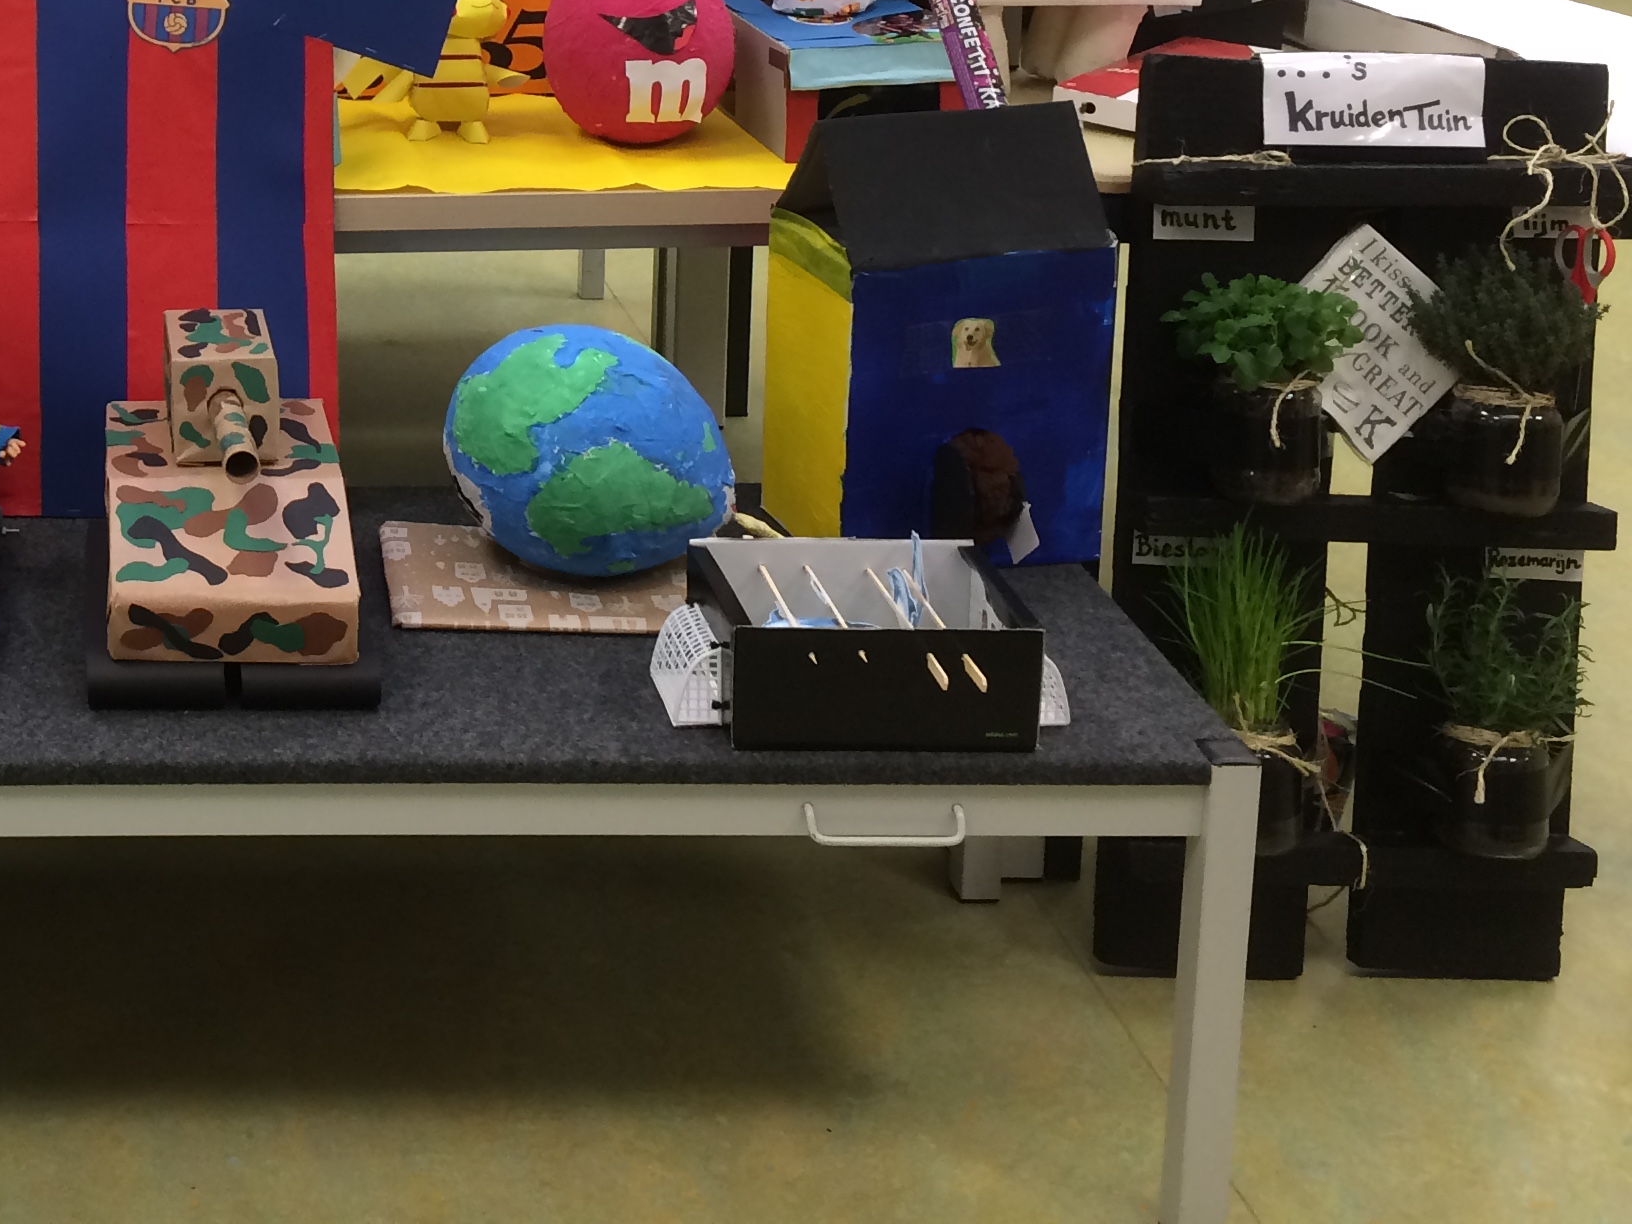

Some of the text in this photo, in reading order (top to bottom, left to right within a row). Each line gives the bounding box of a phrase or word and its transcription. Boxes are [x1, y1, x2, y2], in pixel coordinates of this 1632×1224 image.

[625, 57, 707, 124] m
[1161, 208, 1237, 231] munt
[1352, 352, 1423, 418] GREAT
[1398, 362, 1437, 395] and
[1354, 403, 1398, 450] K
